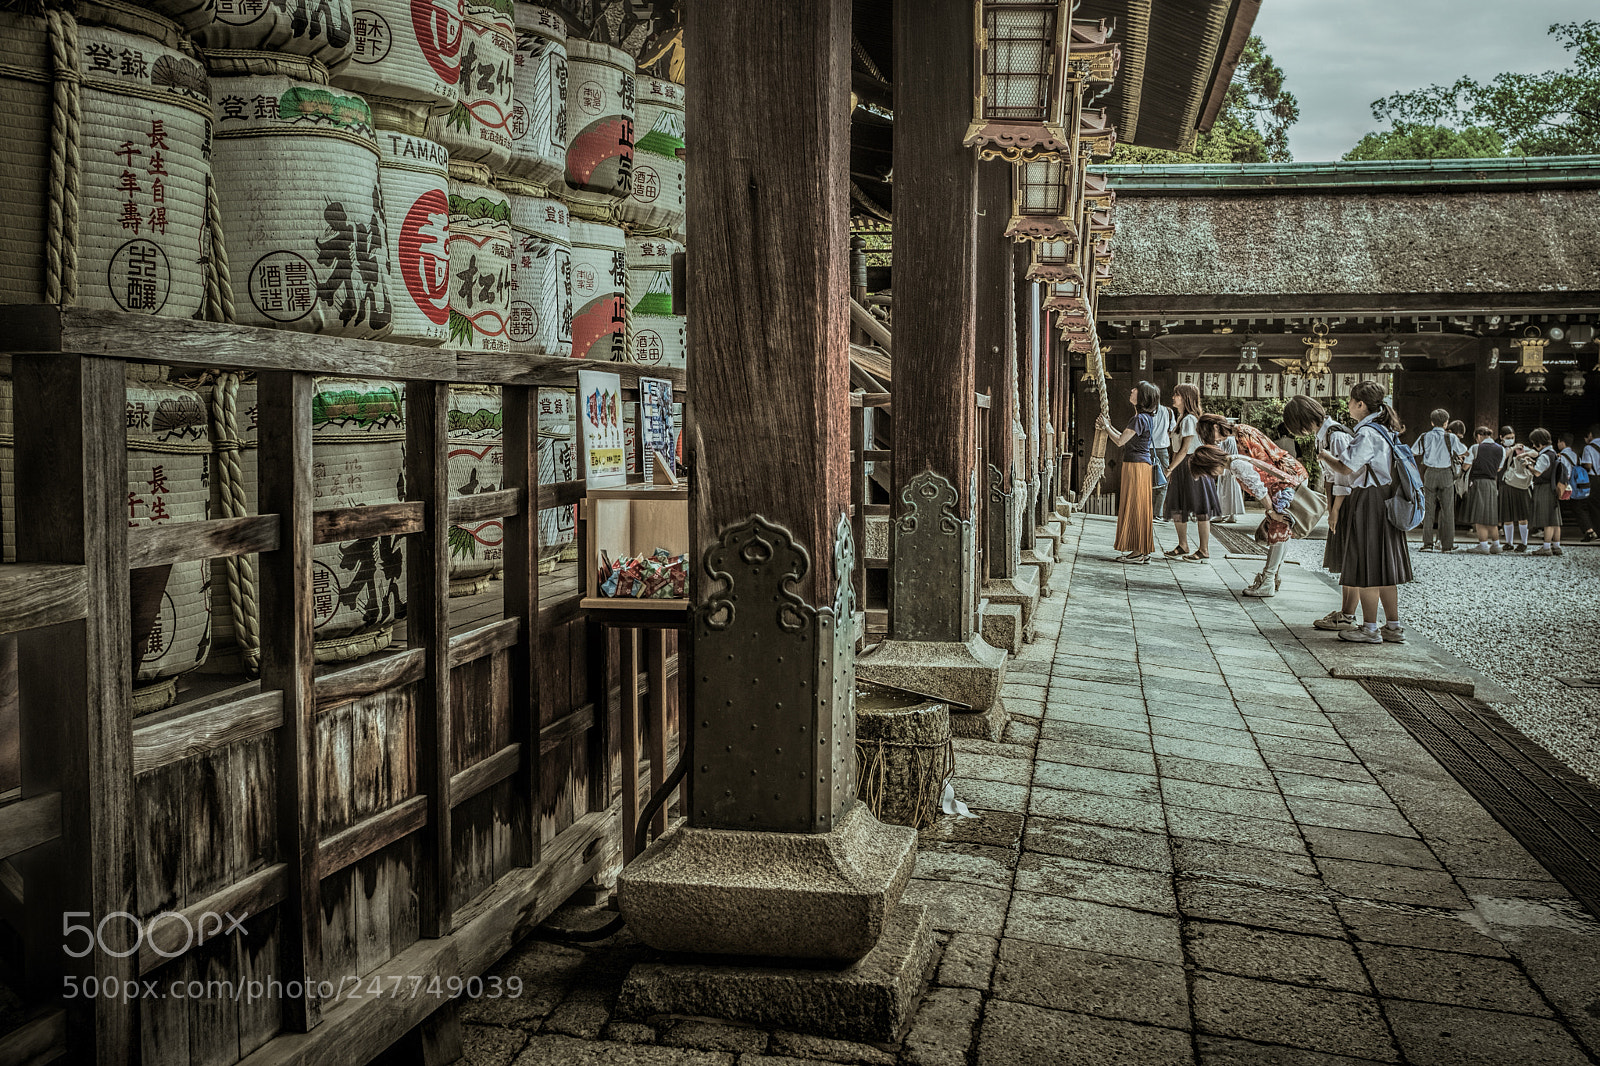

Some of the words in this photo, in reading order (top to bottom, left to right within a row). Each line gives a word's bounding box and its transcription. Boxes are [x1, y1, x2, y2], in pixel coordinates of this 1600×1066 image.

[84, 42, 150, 80] 登録
[217, 94, 282, 122] 登録
[146, 119, 169, 236] 長生自得
[633, 170, 645, 197] 酒造
[645, 172, 657, 198] 太田
[258, 263, 283, 312] 酒造
[636, 335, 648, 361] 酒造
[648, 335, 660, 361] 太田
